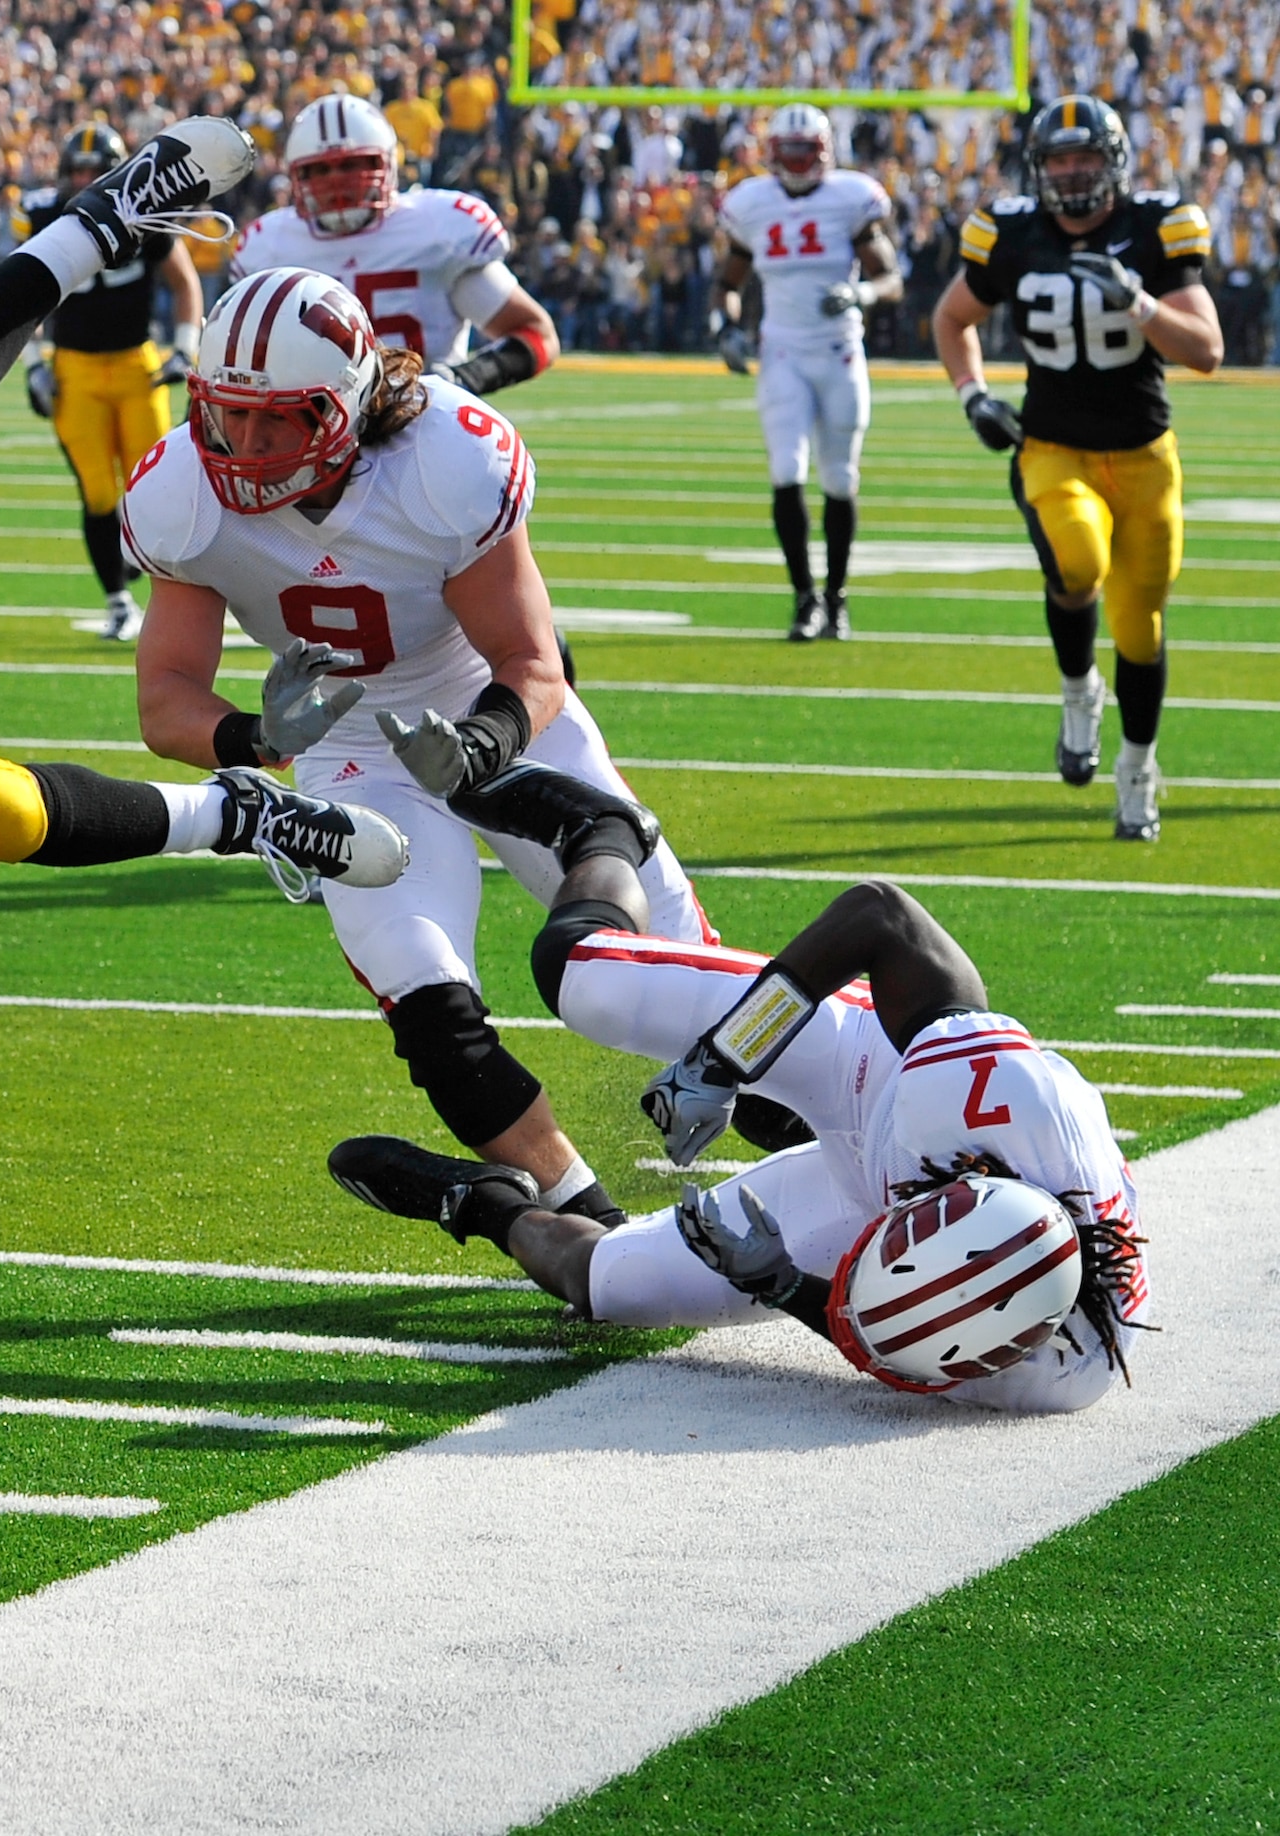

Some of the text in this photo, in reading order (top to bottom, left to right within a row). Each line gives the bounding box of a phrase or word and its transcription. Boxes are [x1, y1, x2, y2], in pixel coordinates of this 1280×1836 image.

[766, 220, 826, 258] 11
[1017, 271, 1147, 372] 36
[457, 405, 512, 453] 9
[125, 440, 168, 493] 9
[278, 584, 396, 678] 9
[963, 1056, 1011, 1129] 7
